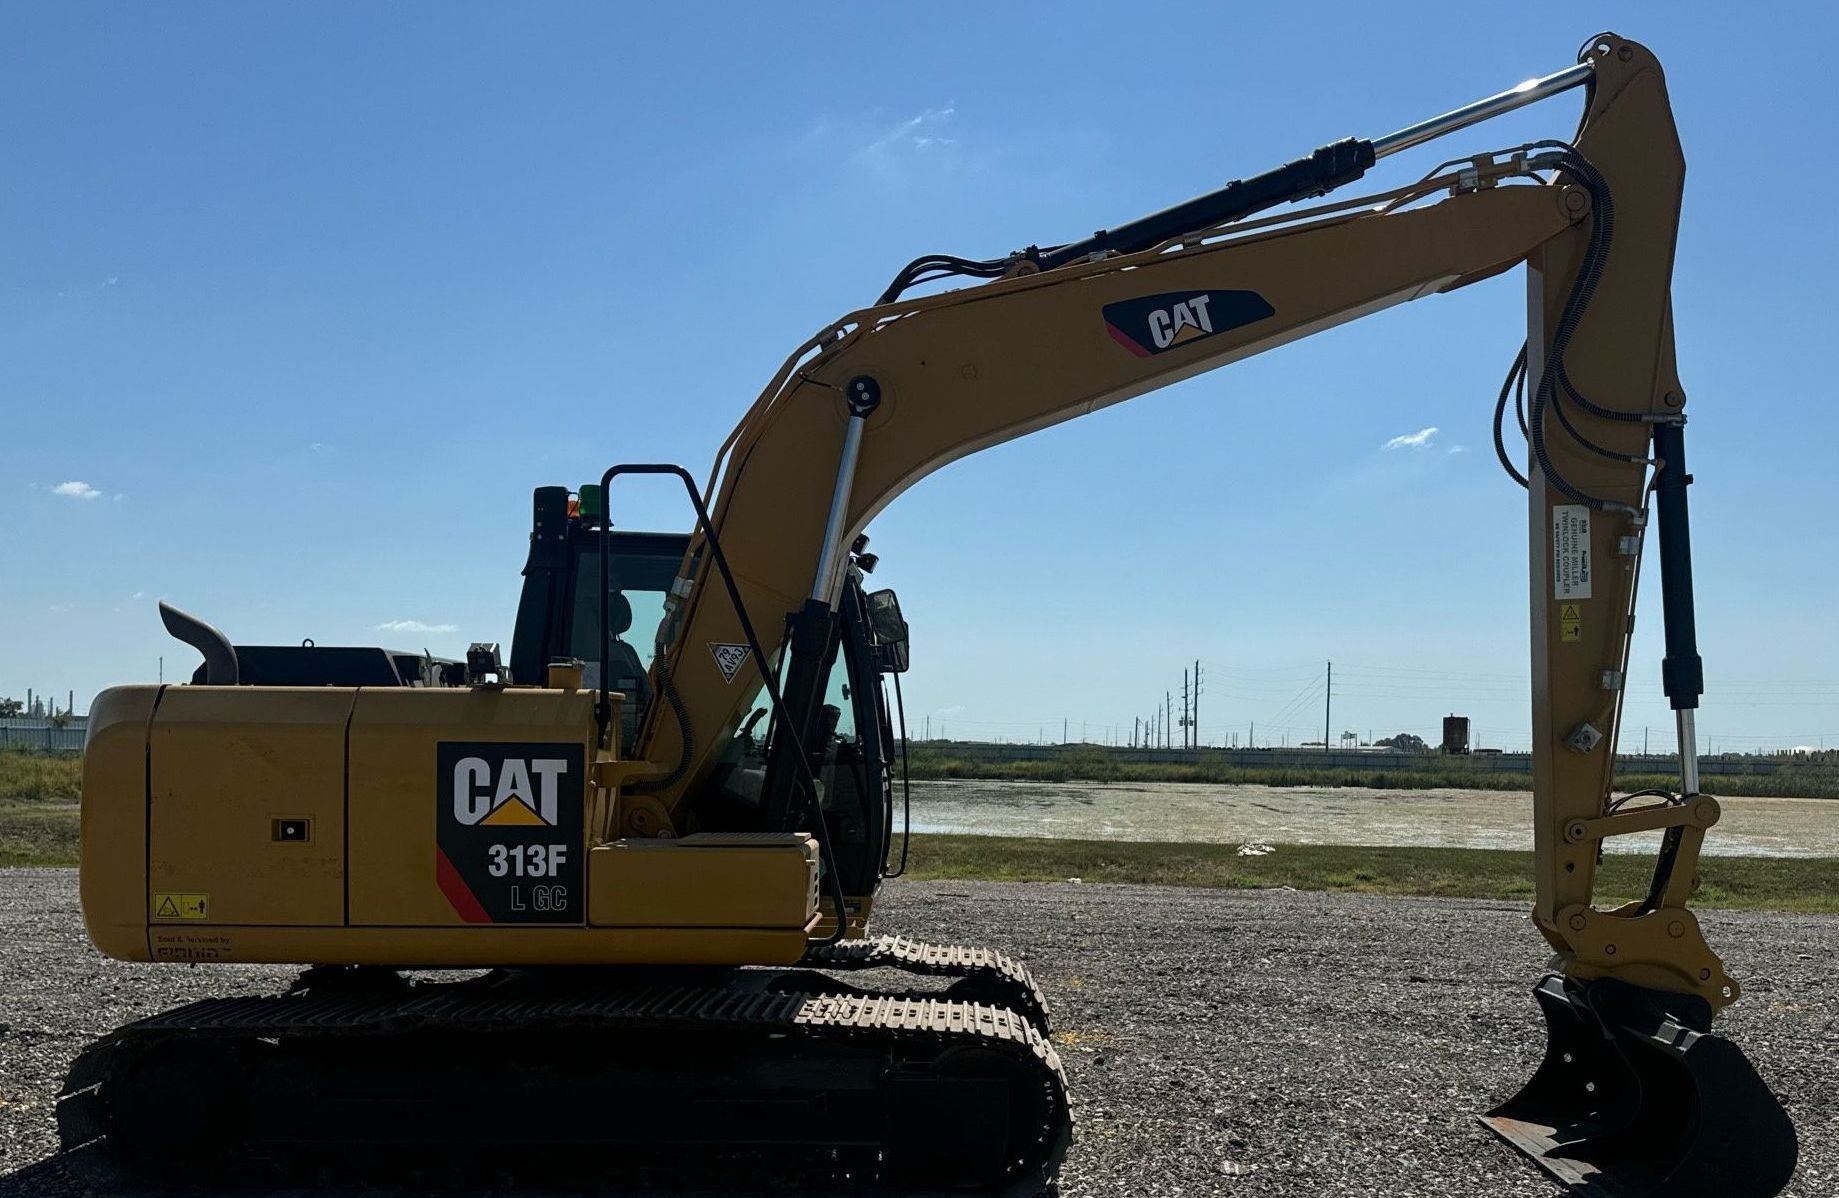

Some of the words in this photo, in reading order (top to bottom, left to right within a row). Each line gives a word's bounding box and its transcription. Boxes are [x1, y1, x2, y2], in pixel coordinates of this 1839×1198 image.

[1148, 294, 1213, 349] CAT
[1561, 511, 1569, 554] TWINLOCK
[1570, 518, 1578, 555] GENUINE
[1571, 556, 1579, 586] MILLER
[718, 648, 731, 661] 79
[724, 647, 744, 671] AV9J
[454, 757, 568, 826] CAT
[488, 844, 567, 877] 313F
[511, 885, 525, 911] L
[533, 885, 567, 911] GC
